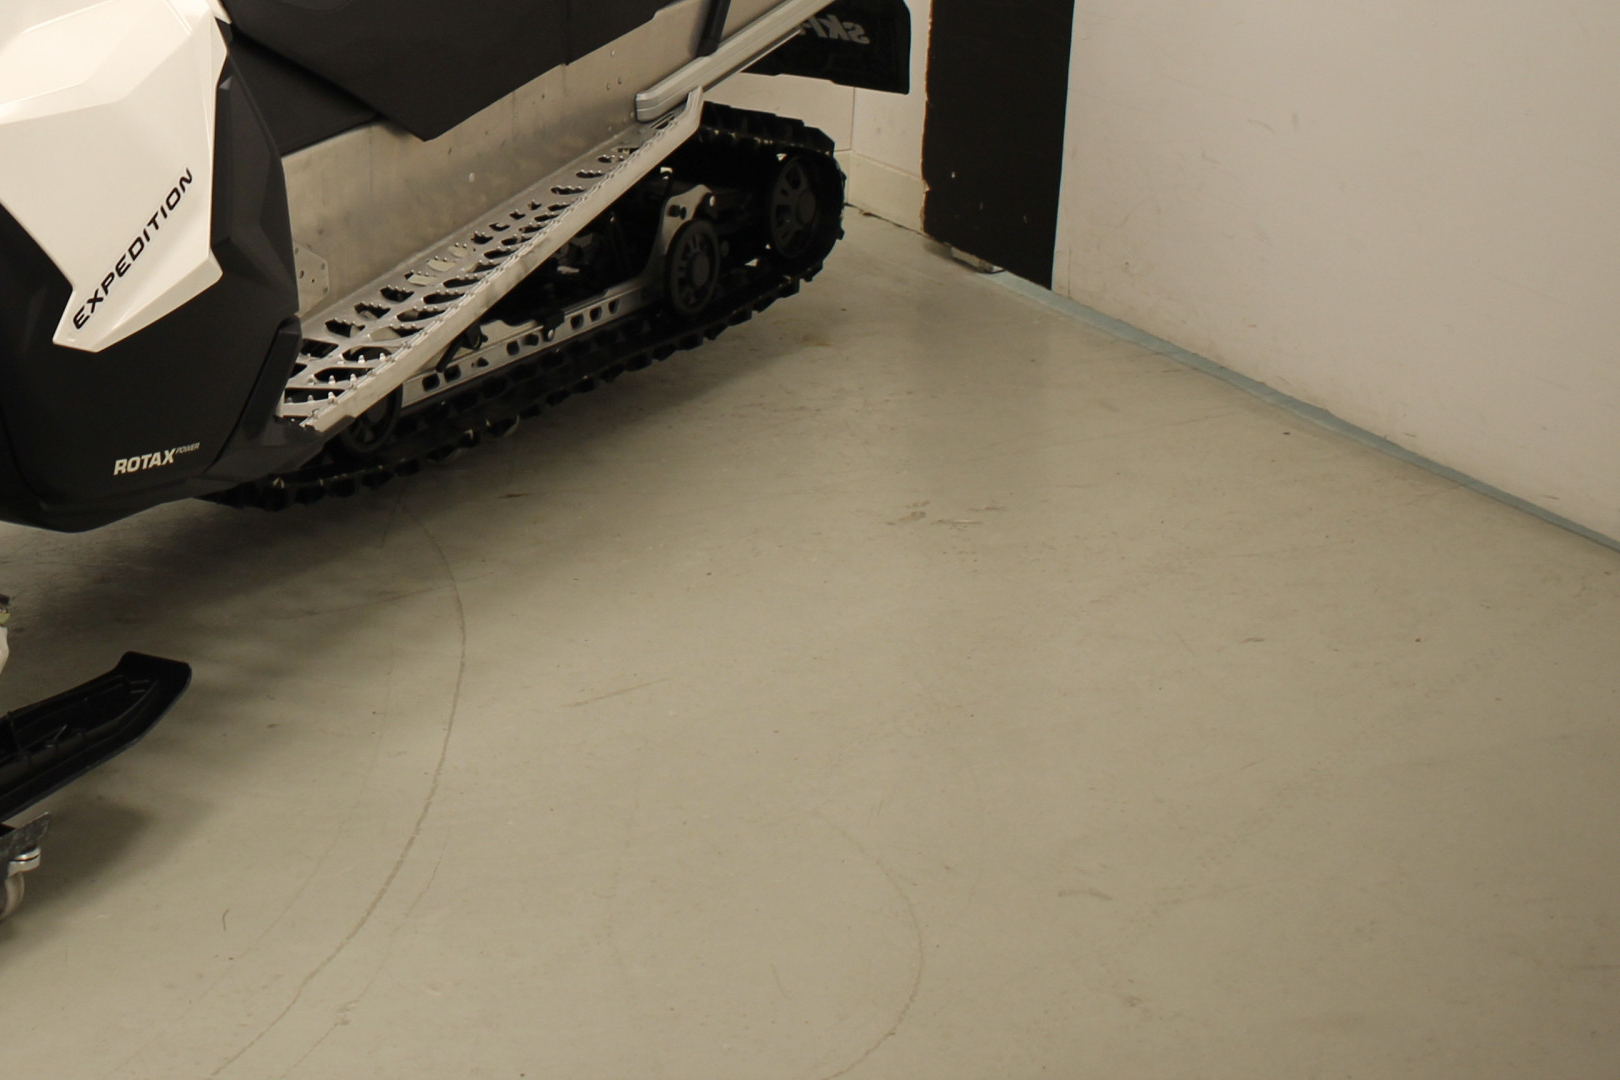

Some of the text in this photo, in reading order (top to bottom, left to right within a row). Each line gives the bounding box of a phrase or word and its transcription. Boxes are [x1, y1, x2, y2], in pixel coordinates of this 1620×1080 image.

[72, 167, 193, 330] EXPEDITION
[113, 442, 201, 476] ROTAX POWER
